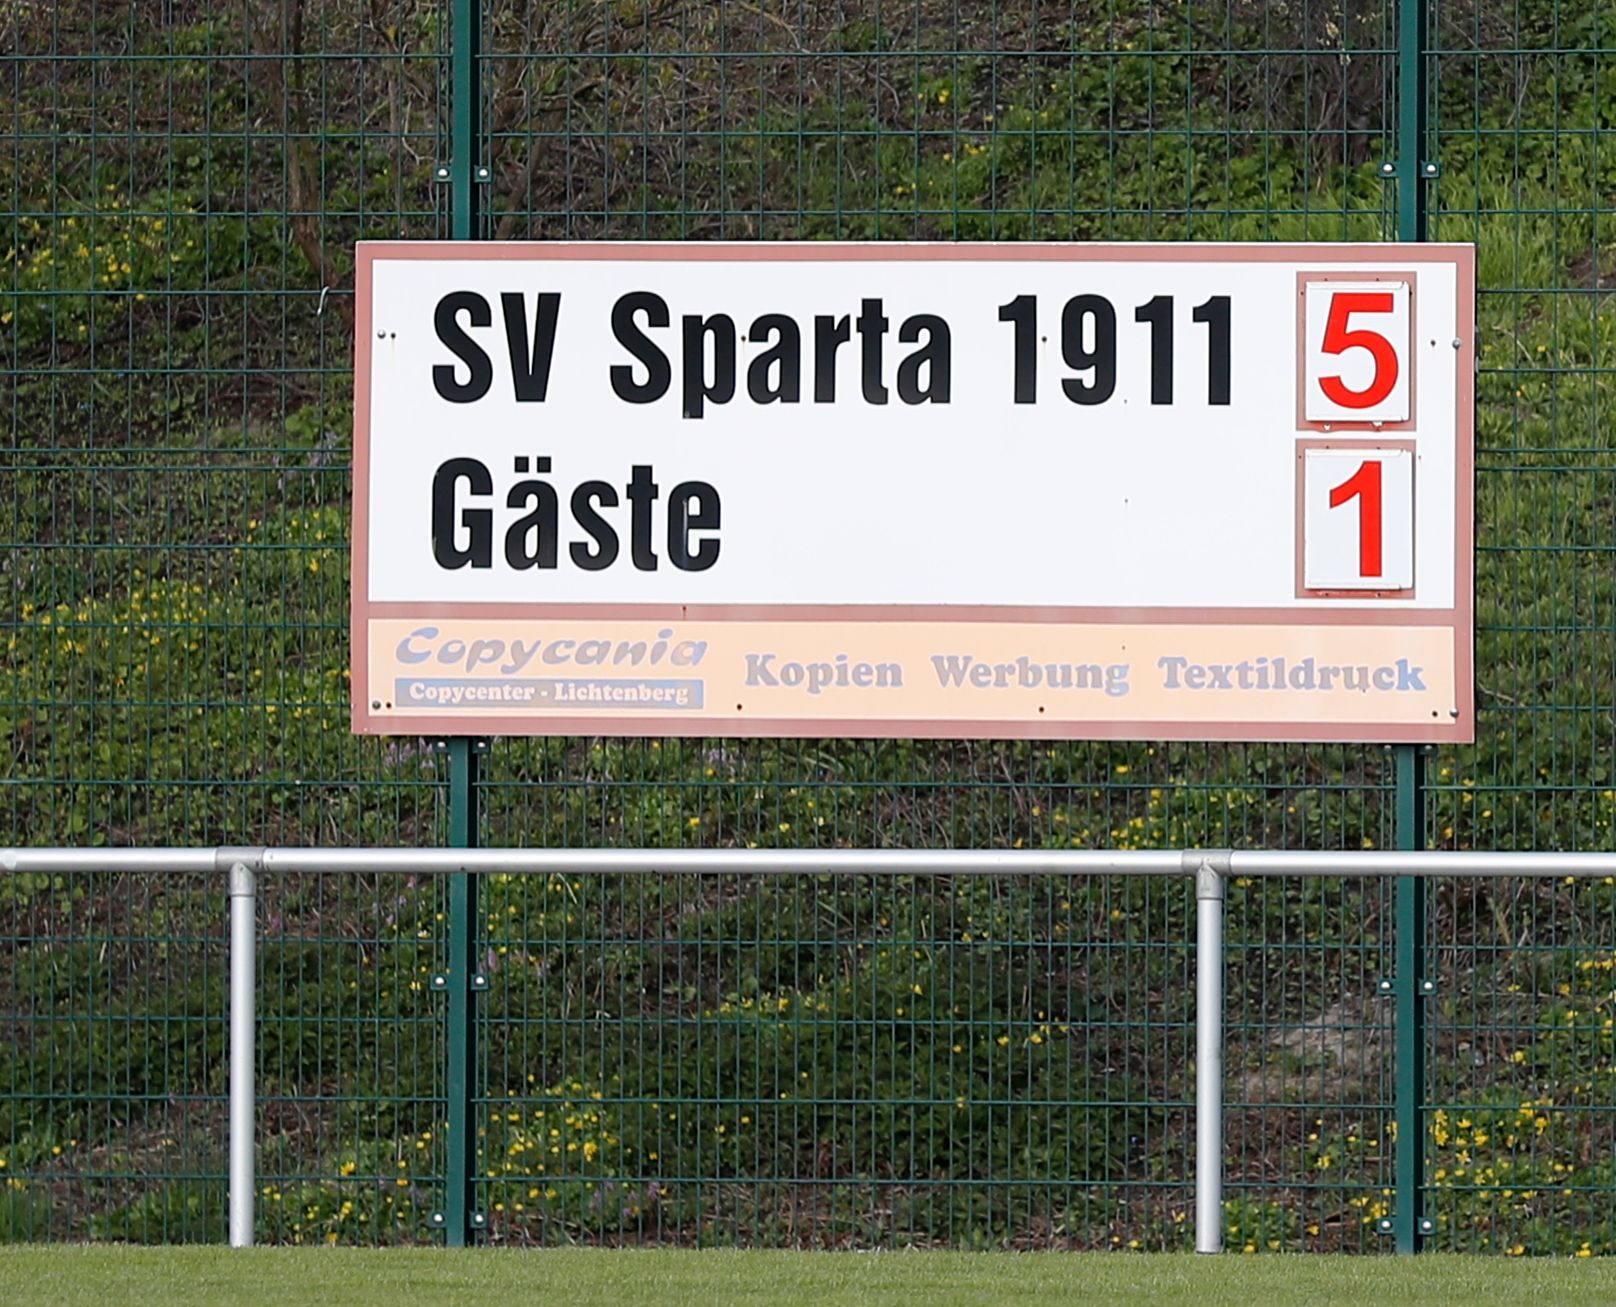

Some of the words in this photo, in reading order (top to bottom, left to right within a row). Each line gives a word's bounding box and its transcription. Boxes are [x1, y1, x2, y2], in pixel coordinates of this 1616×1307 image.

[432, 290, 561, 404] SV
[609, 291, 952, 419] Sparta
[998, 293, 1231, 407] 1911
[1318, 292, 1399, 409] 5
[431, 456, 721, 572] Gäste
[1329, 460, 1382, 577] 1
[395, 626, 708, 675] Copycania
[409, 682, 536, 702] Copycenter
[554, 683, 690, 705] Lichtenberg
[746, 654, 902, 694] Kopien
[931, 655, 1130, 697] Werbung
[1158, 656, 1427, 692] Textildruck
